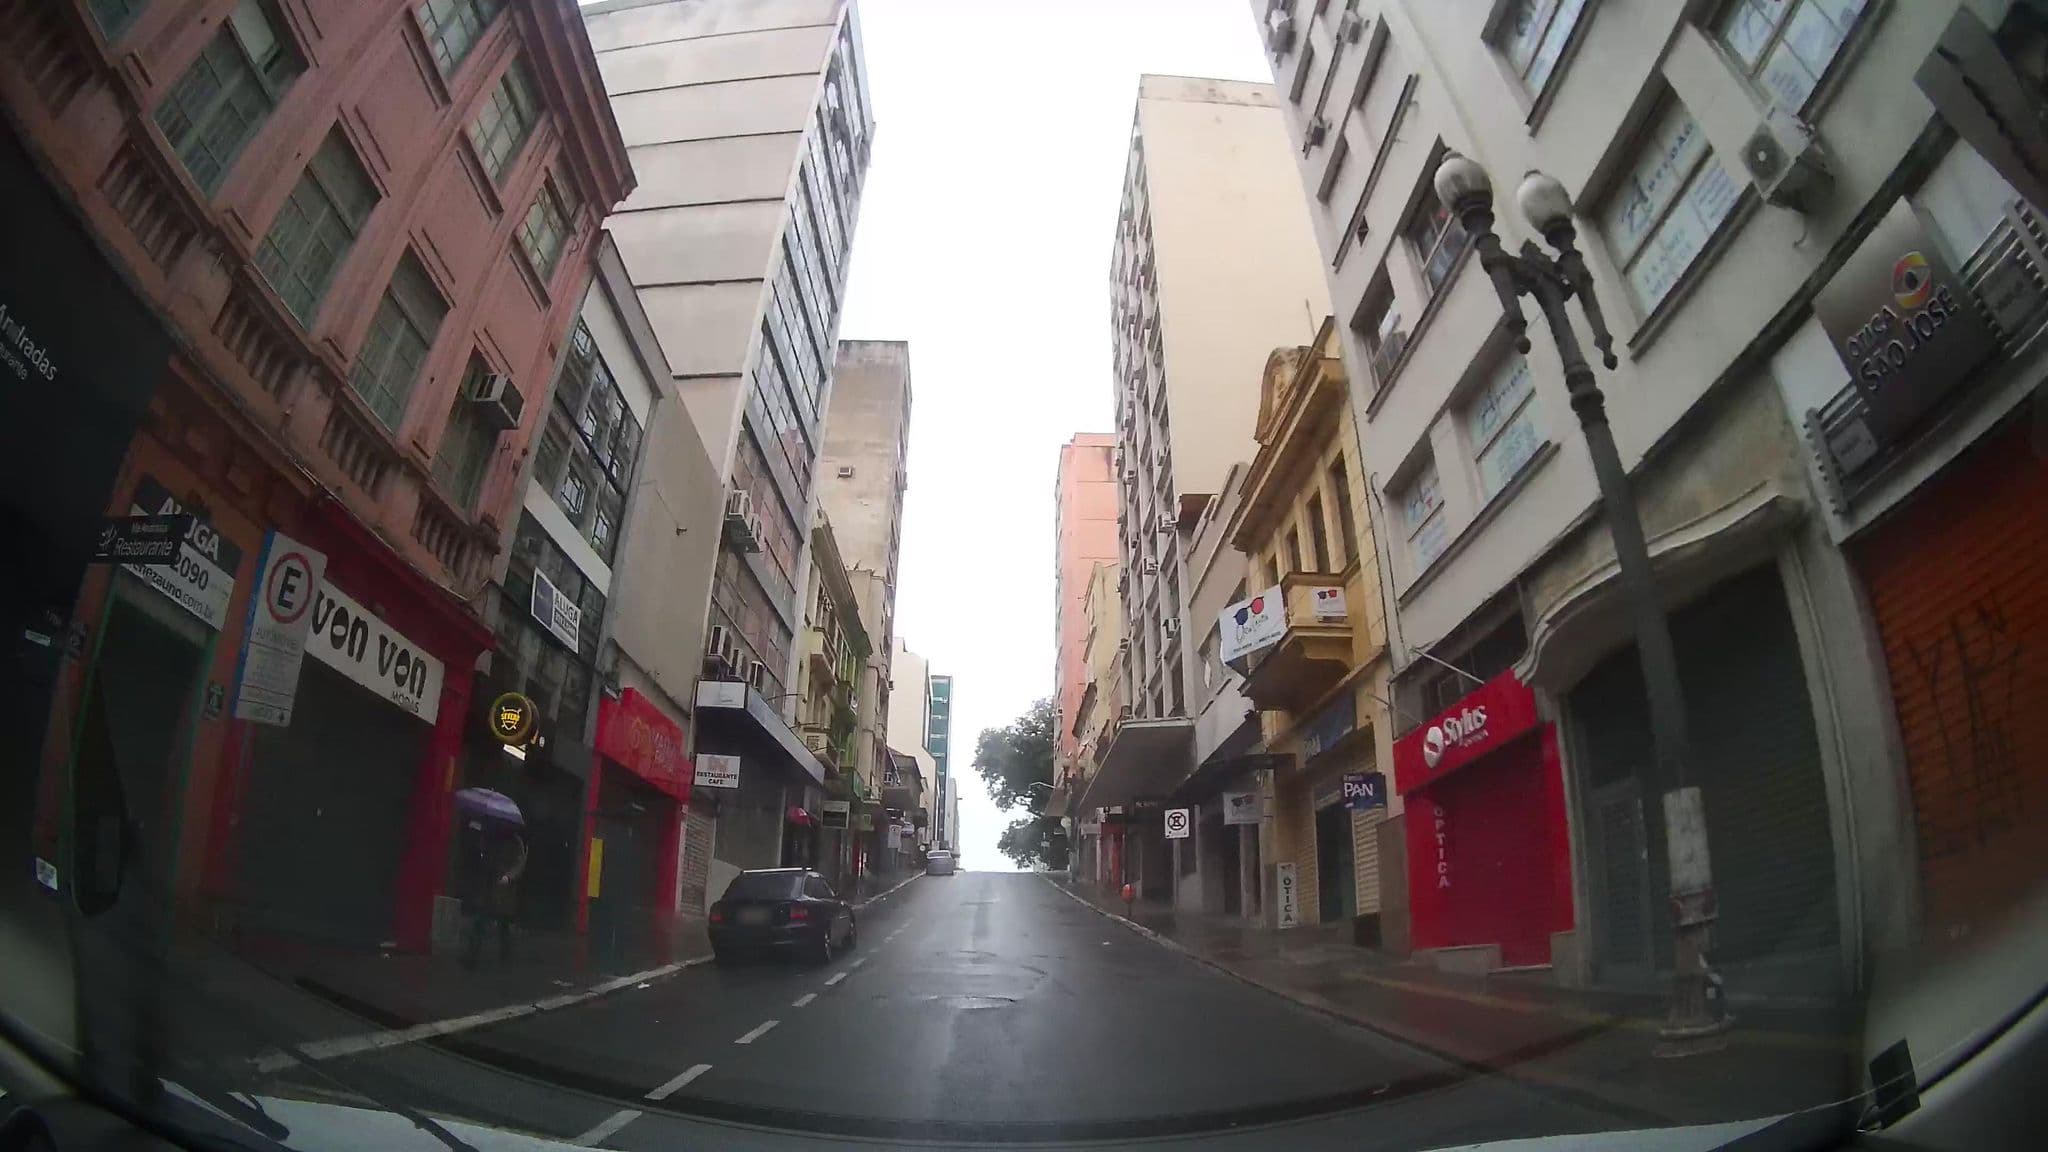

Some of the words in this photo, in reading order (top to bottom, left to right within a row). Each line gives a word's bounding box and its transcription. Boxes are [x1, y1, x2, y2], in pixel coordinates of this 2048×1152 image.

[120, 537, 173, 557] Restaurante
[277, 566, 303, 610] E
[553, 592, 578, 624] ALUGA
[312, 589, 369, 664] von
[378, 633, 427, 699] von
[1343, 782, 1374, 798] PAN
